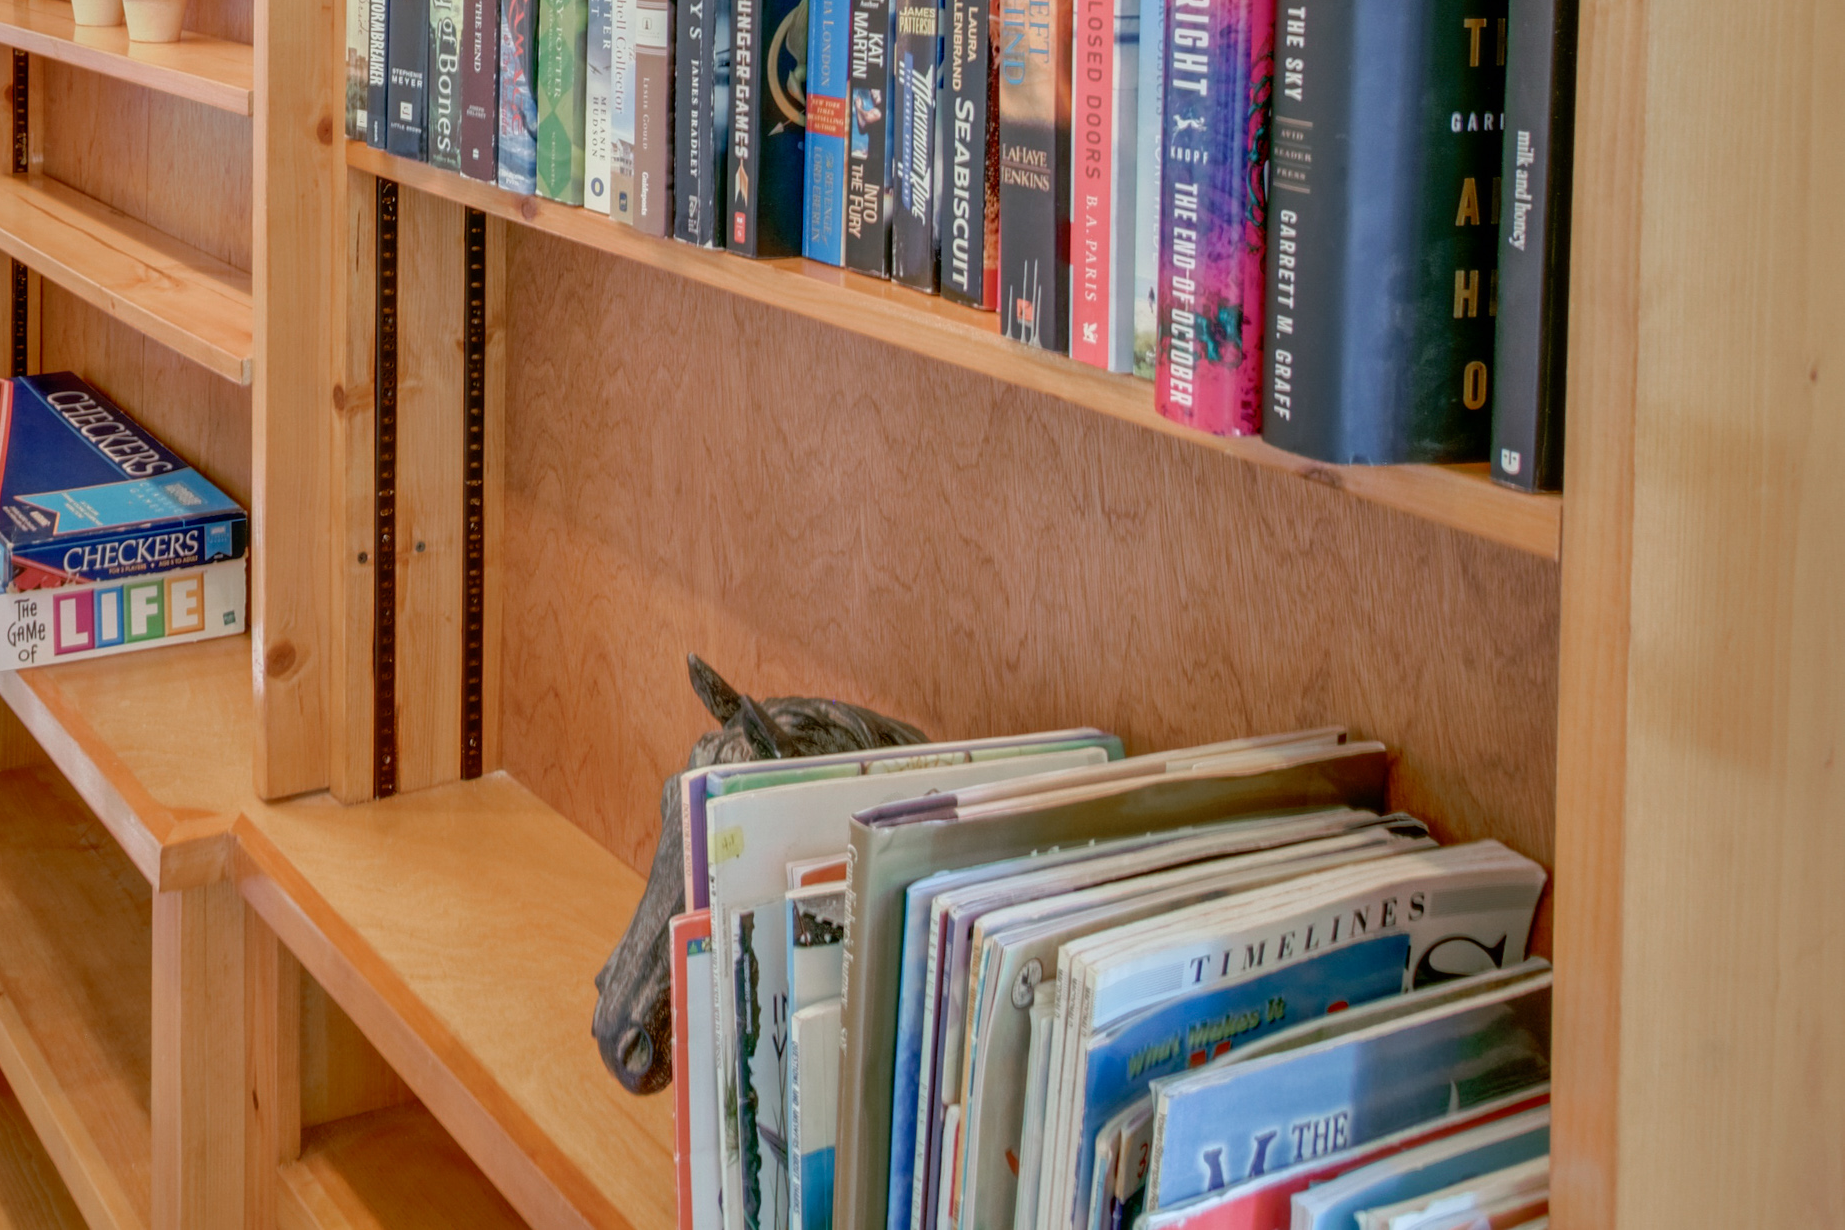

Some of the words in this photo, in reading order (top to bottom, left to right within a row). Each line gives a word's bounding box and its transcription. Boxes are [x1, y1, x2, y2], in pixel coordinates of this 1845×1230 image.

[438, 18, 456, 46] of
[475, 1, 483, 30] THE
[899, 6, 935, 18] JAMES
[899, 16, 935, 36] PATTERSON
[966, 6, 979, 62] LAURA
[1286, 6, 1306, 48] THE
[473, 32, 482, 74] FIEND
[553, 27, 563, 99] POTTER
[821, 20, 835, 88] LONDON
[852, 11, 868, 79] MARTIN
[867, 32, 884, 68] KAT
[391, 76, 423, 88] MEYER
[392, 68, 423, 79] STEPHENIE
[613, 36, 626, 115] Collector
[643, 77, 651, 110] LESLIE
[690, 59, 700, 106] JAMES
[1284, 57, 1304, 102] SKY
[436, 52, 458, 151] Bones
[733, 84, 750, 159] GAMES
[903, 63, 935, 176] MAXIMUM
[591, 96, 599, 158] HUDSON
[599, 96, 608, 161] MELANIE
[641, 113, 650, 150] GOULD
[689, 109, 699, 177] BRADLEY
[1085, 95, 1102, 180] DOORS
[1281, 128, 1304, 141] AVID
[1516, 130, 1535, 167] milk
[814, 146, 823, 184] LORD
[1170, 145, 1209, 165] KNOPF
[1274, 147, 1312, 163] READER
[640, 171, 649, 216] Guideposts
[850, 164, 865, 193] THE
[908, 163, 931, 225] RIDE
[952, 97, 974, 292] SEABISCUIT
[1001, 166, 1050, 192] JENKINS
[1515, 169, 1533, 201] and
[811, 185, 822, 243] EBERLIN
[823, 172, 833, 236] REVENGE
[848, 195, 863, 239] FURY
[863, 183, 880, 224] INTO
[1085, 195, 1098, 210] B.
[1085, 213, 1098, 235] A.
[1173, 182, 1198, 223] THE
[1173, 229, 1196, 270] END
[1509, 202, 1532, 252] honey
[1083, 238, 1098, 303] PARIS
[1275, 208, 1297, 309] GARRETT
[1172, 275, 1195, 306] OF
[1275, 314, 1293, 340] M.
[1169, 308, 1195, 408] OCTOBER
[1272, 349, 1292, 422] GRAFF
[47, 389, 173, 479] CHECKERS
[63, 529, 199, 574] CHECKERS
[57, 575, 201, 652] LIFE
[1189, 891, 1427, 985] TIMELINES
[840, 948, 854, 1012] Journey
[1127, 1031, 1181, 1079] What
[1187, 1005, 1262, 1049] Makes
[1264, 995, 1286, 1024] It
[1292, 1111, 1350, 1163] THE
